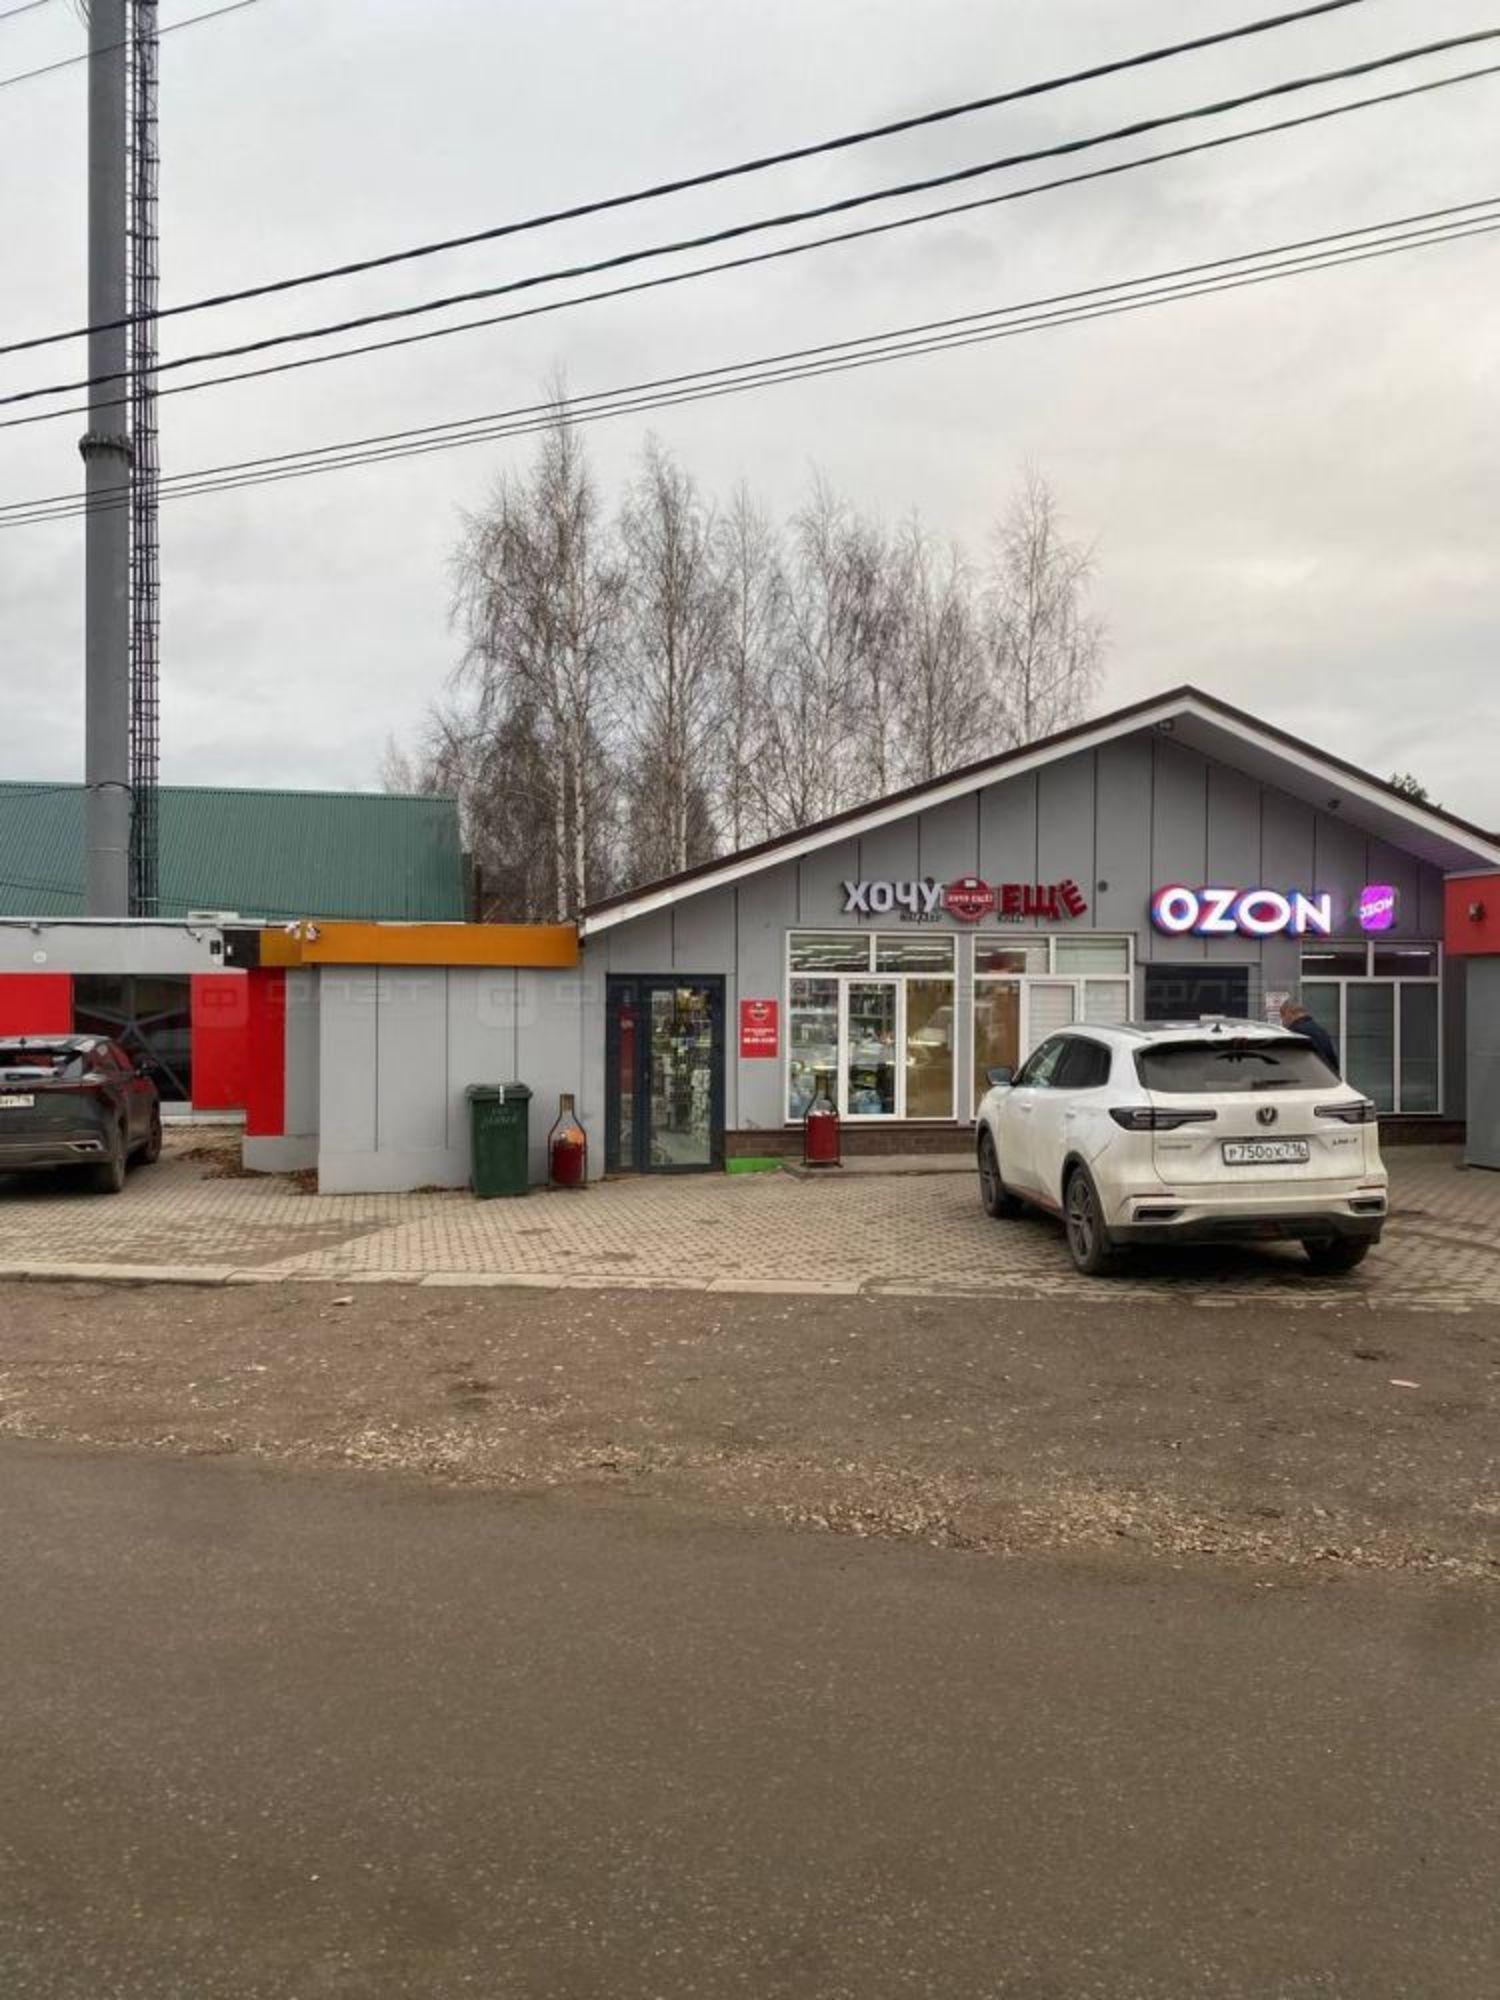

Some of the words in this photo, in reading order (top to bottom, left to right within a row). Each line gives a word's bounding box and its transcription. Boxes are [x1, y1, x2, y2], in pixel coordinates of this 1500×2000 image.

[844, 880, 943, 912] ХОЧУ
[1002, 879, 1088, 922] ЕЩЁ
[1154, 885, 1331, 936] OZON
